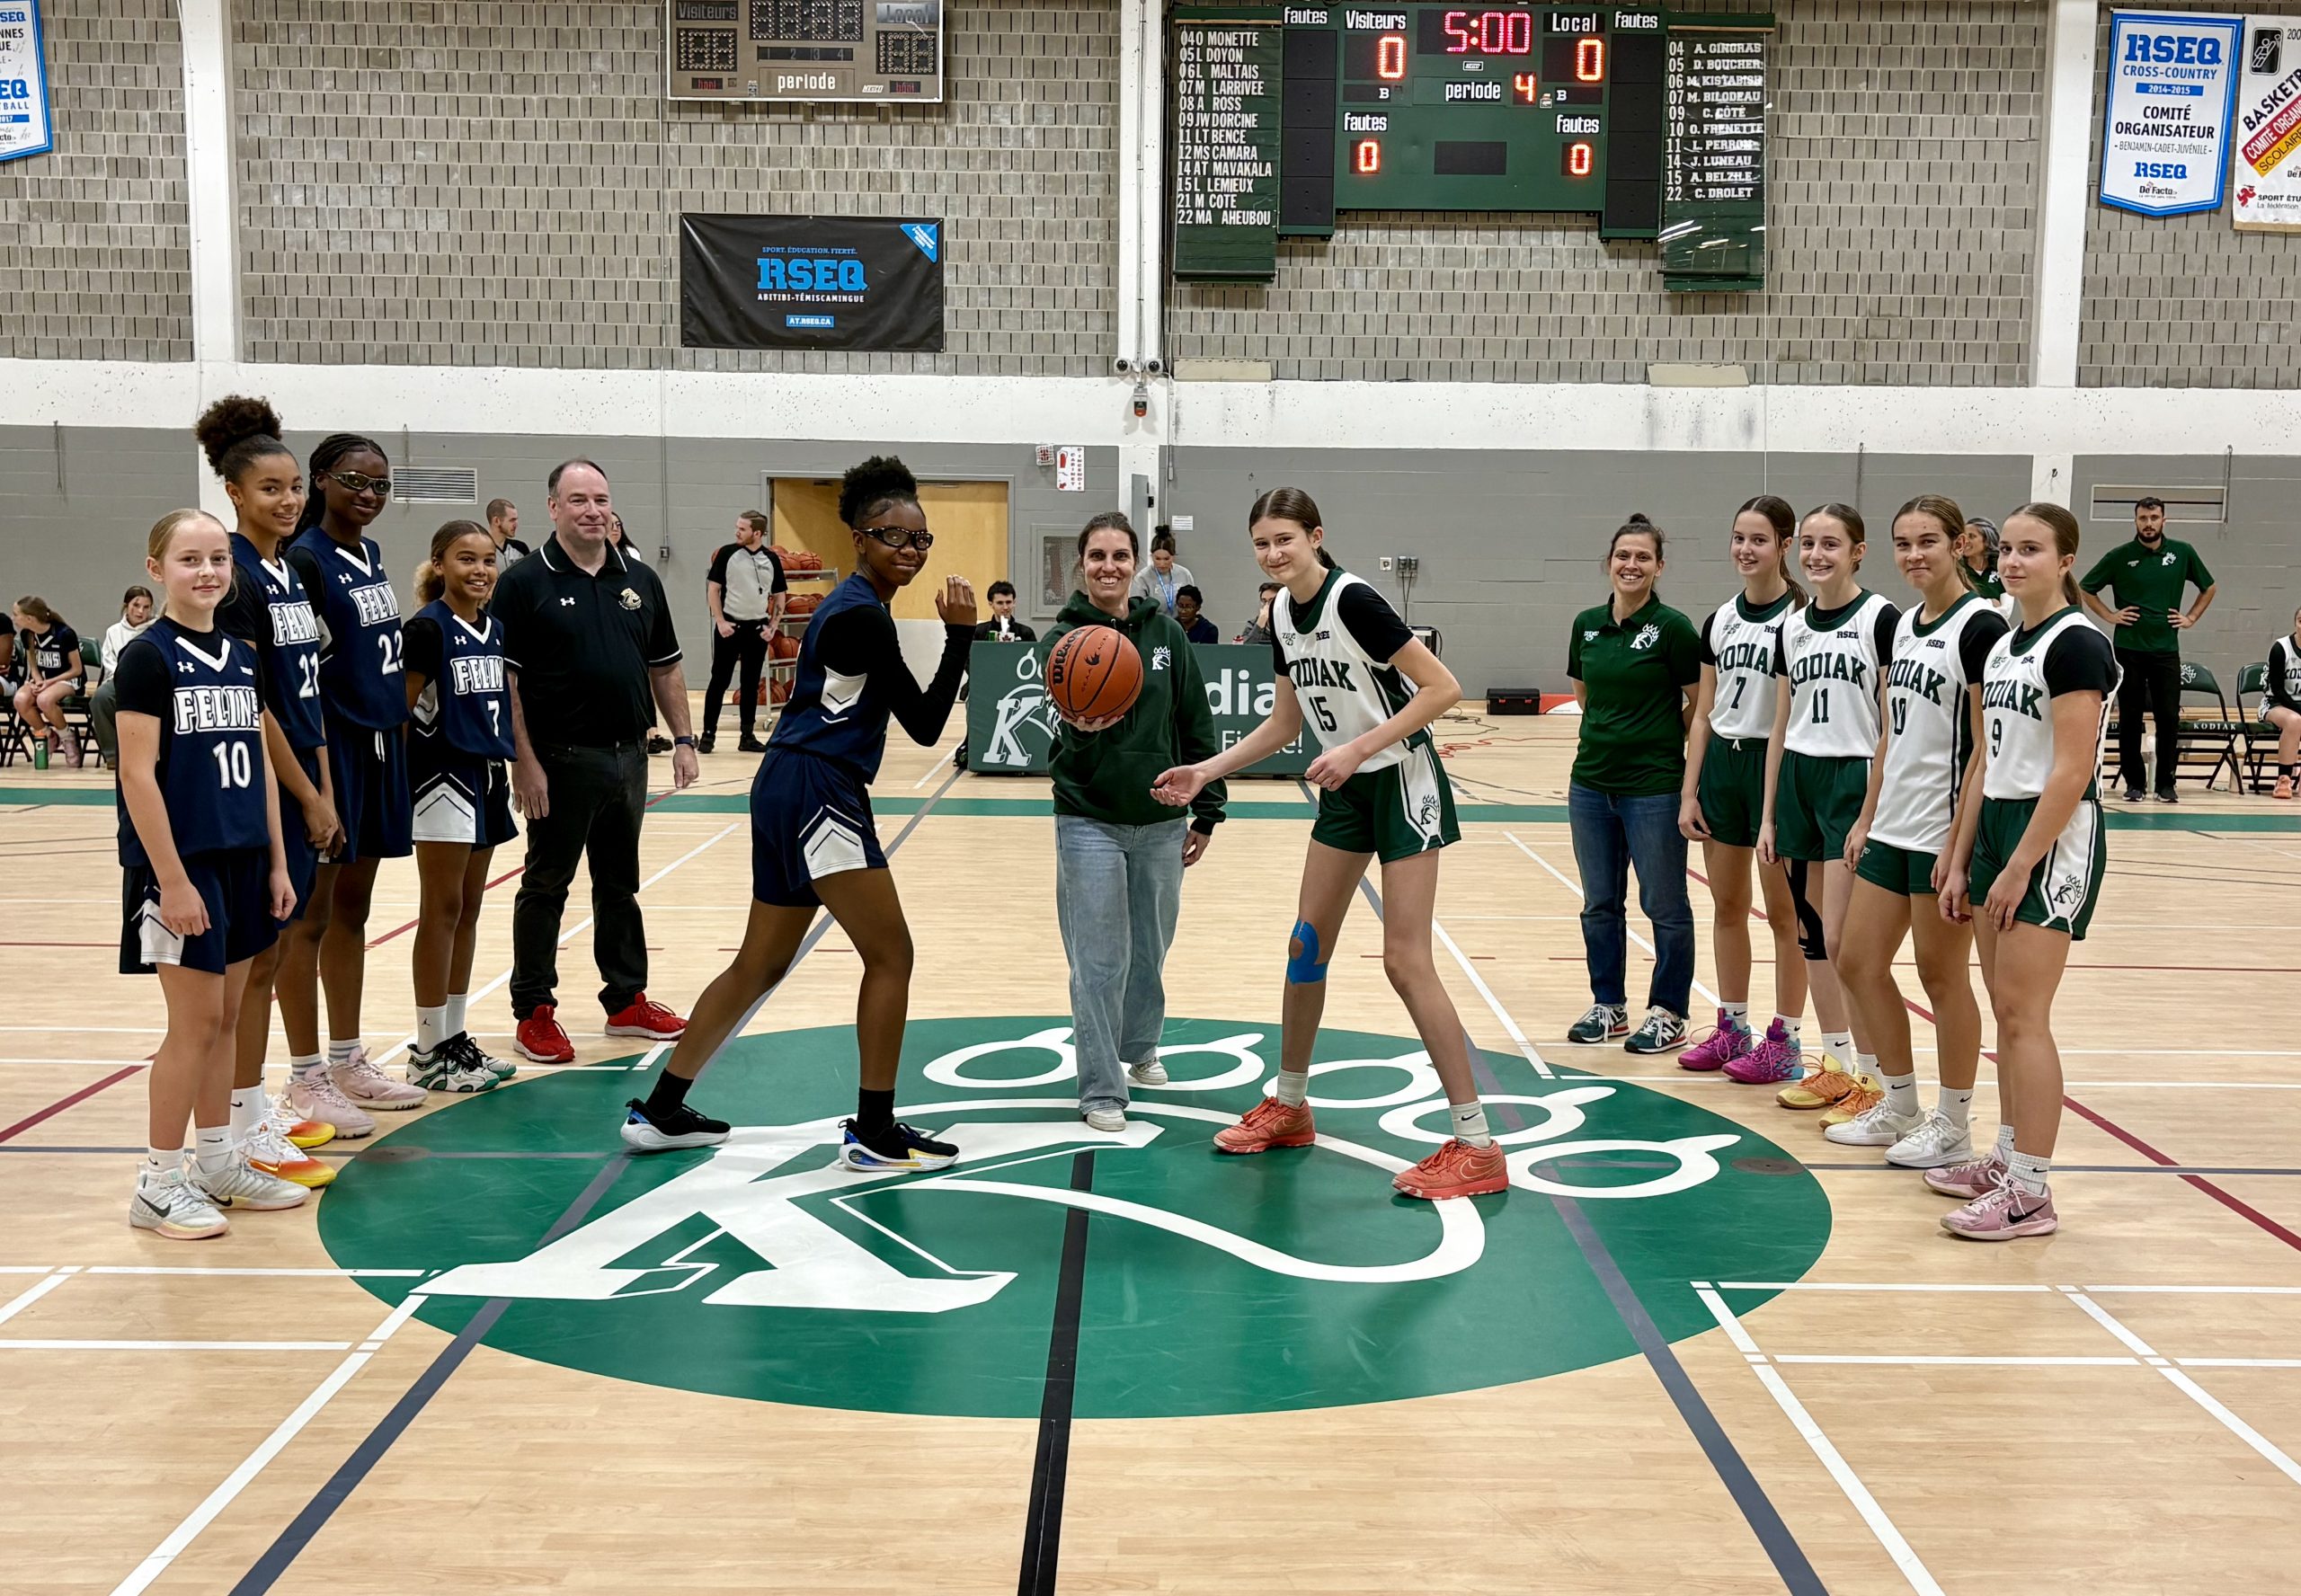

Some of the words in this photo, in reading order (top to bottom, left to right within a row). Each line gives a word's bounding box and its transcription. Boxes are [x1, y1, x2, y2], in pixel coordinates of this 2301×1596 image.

[678, 2, 737, 19] Visiteurs
[1346, 10, 1407, 30] Visiteurs
[1552, 13, 1596, 32] Local
[1180, 31, 1195, 46] 04
[1207, 31, 1259, 47] MONETTE
[1444, 12, 1531, 53] 5:00
[1179, 47, 1195, 62] 05
[1196, 48, 1203, 62] L
[1206, 48, 1243, 63] DOYON
[1668, 41, 1684, 56] 04
[1709, 42, 1762, 53] GINGRAS
[2124, 33, 2223, 65] RSEQ
[1378, 36, 1405, 78] 0
[1577, 39, 1603, 81] 0
[1668, 58, 1684, 72] 05
[1707, 58, 1762, 70] BOUCHER
[1179, 63, 1195, 79] 06
[1196, 64, 1203, 78] L
[1211, 64, 1259, 79] MALTAIS
[2123, 65, 2217, 80] CROSS-COUNTRY
[777, 72, 836, 93] periode
[1179, 80, 1194, 94] 07
[1195, 80, 1204, 94] M
[1213, 80, 1265, 95] LARRIVEE
[1445, 81, 1501, 102] periode
[1515, 75, 1534, 102] 4
[1668, 74, 1684, 89] 06
[2148, 84, 2190, 94] 2014-2015
[1378, 88, 1390, 99] B
[1556, 89, 1567, 102] B
[1668, 90, 1684, 105] 07
[1703, 91, 1761, 102] BILODEAU
[0, 102, 29, 110] BALL
[1179, 96, 1195, 111] 08
[1197, 96, 1204, 111] A
[1213, 96, 1242, 111] ROSS
[2143, 103, 2191, 120] COMITÉ
[1179, 112, 1195, 128] 09
[1195, 113, 1211, 127] JW
[1212, 113, 1258, 129] DORCINE
[1668, 106, 1684, 120] 09
[1178, 129, 1191, 144] 11
[1195, 129, 1209, 144] LT
[1212, 129, 1247, 144] BENCE
[1669, 122, 1684, 137] 10
[2115, 121, 2215, 139] ORGANISATEUR
[1666, 137, 1681, 153] 11
[1178, 146, 1192, 160] 12
[1194, 146, 1210, 160] MS
[1212, 146, 1258, 161] CAMARA
[1359, 141, 1378, 172] 0
[1570, 144, 1590, 174] 0
[1666, 154, 1681, 169] 14
[1703, 155, 1752, 166] LUNEAU
[1178, 162, 1191, 176] 14
[1194, 162, 1209, 176] AT
[1213, 162, 1273, 177] MAVAKALA
[1666, 170, 1682, 185] 15
[2134, 162, 2188, 179] RSEQ
[1177, 178, 1192, 191] 15
[1194, 178, 1201, 192] L
[1207, 178, 1254, 193] LEMIEUX
[1666, 186, 1683, 200] 22
[1708, 187, 1754, 198] DROLET
[1177, 194, 1191, 208] 21
[1195, 194, 1204, 208] M
[1209, 194, 1238, 208] COTE
[1177, 209, 1193, 224] 22
[1195, 210, 1213, 224] MA
[1222, 210, 1271, 225] AHEUBOU
[757, 258, 868, 291] RSEQ
[757, 292, 865, 303] ABITIBI-TÉMISCAMINGUE
[349, 581, 401, 627] FELI
[268, 600, 320, 646] FELIN
[449, 655, 503, 696] FELIN
[1886, 659, 1947, 706] ODIAK
[1204, 669, 1276, 716] dia
[1730, 676, 1747, 710] 7
[1982, 678, 2043, 722] ODIAK
[1811, 687, 1829, 724] 11
[486, 699, 500, 738] 7
[1309, 696, 1337, 732] 15
[2193, 722, 2237, 731] KODIAK
[1992, 718, 2003, 758] 9
[212, 740, 252, 789] 10
